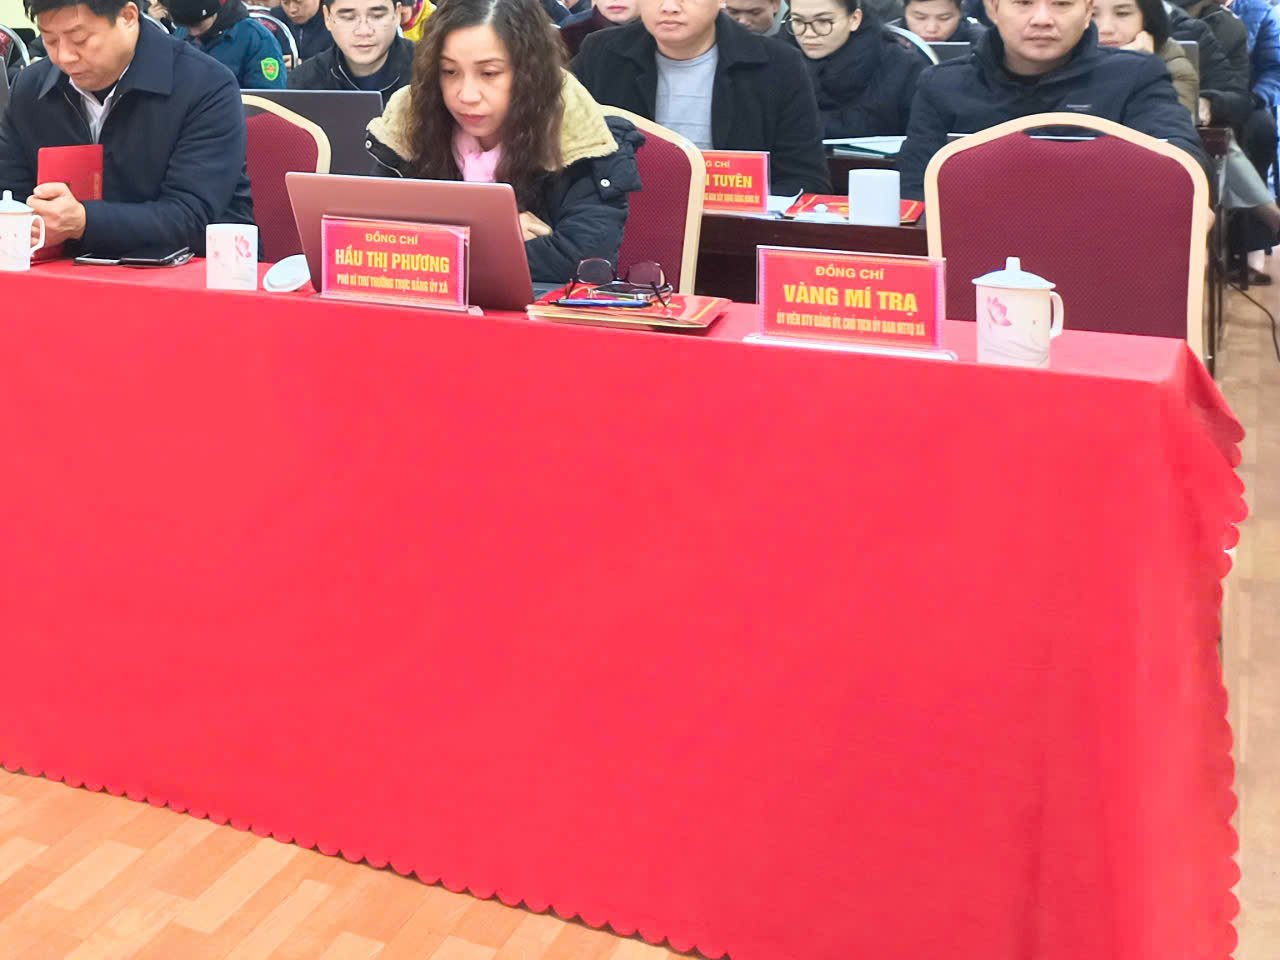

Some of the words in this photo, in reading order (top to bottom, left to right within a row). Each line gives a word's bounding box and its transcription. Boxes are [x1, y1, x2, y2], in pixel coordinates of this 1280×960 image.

[712, 172, 753, 189] TUYÊN
[365, 231, 397, 244] ĐỒNG
[399, 234, 419, 246] CHÍ
[366, 250, 389, 272] THỊ
[391, 253, 450, 273] PHƯƠNG
[815, 263, 856, 278] ĐỒNG
[859, 268, 885, 280] CHÍ
[783, 281, 839, 306] VÀNG
[845, 287, 872, 309] MÍ
[877, 290, 919, 316] TRẠ
